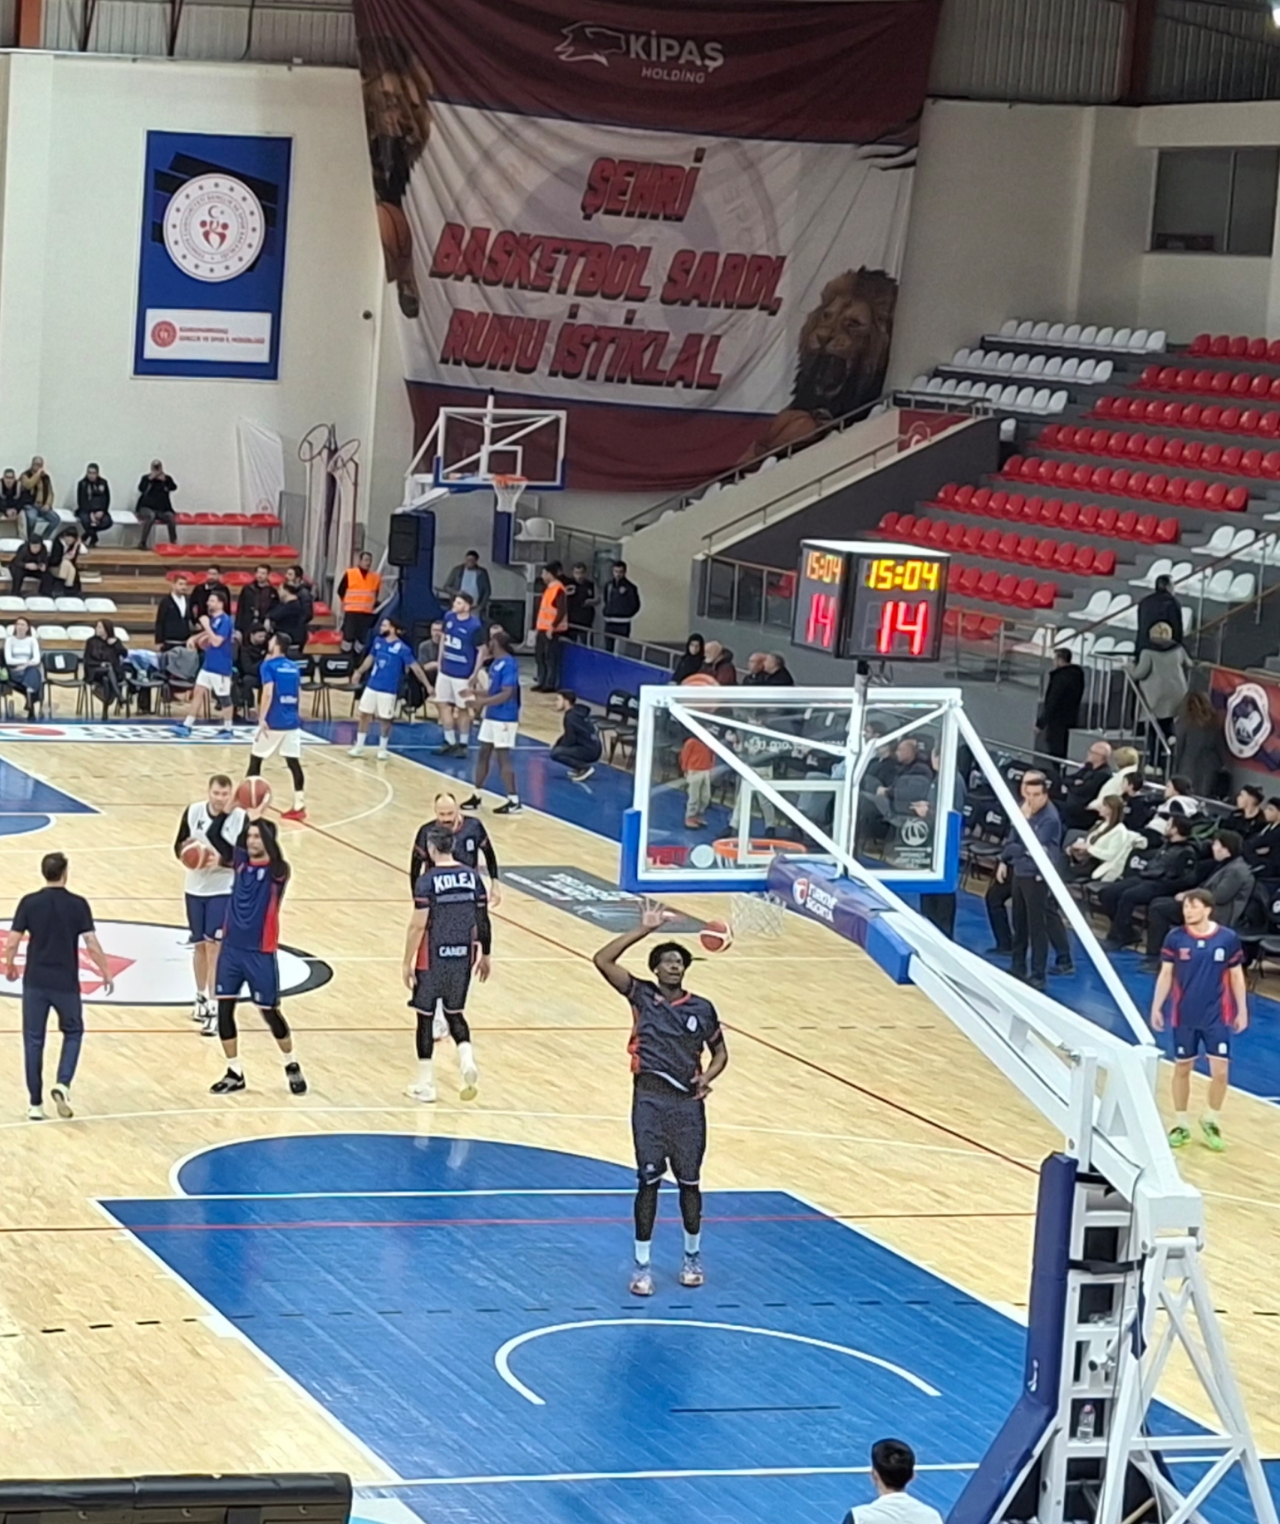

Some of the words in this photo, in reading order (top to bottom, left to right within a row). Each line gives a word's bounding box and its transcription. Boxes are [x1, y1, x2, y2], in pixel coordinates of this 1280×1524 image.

[629, 30, 724, 73] KİPAŞ
[641, 66, 705, 84] HOLDİNG
[581, 147, 707, 221] ŞEHRİ
[429, 222, 652, 303] BASKETBOL
[439, 308, 545, 374] RUHU
[548, 304, 724, 390] İSTİKLAL
[806, 551, 843, 584] 15:04
[868, 559, 940, 591] 15:04
[807, 593, 836, 647] 14
[878, 600, 929, 655] 14
[433, 872, 476, 894] KOLEJ
